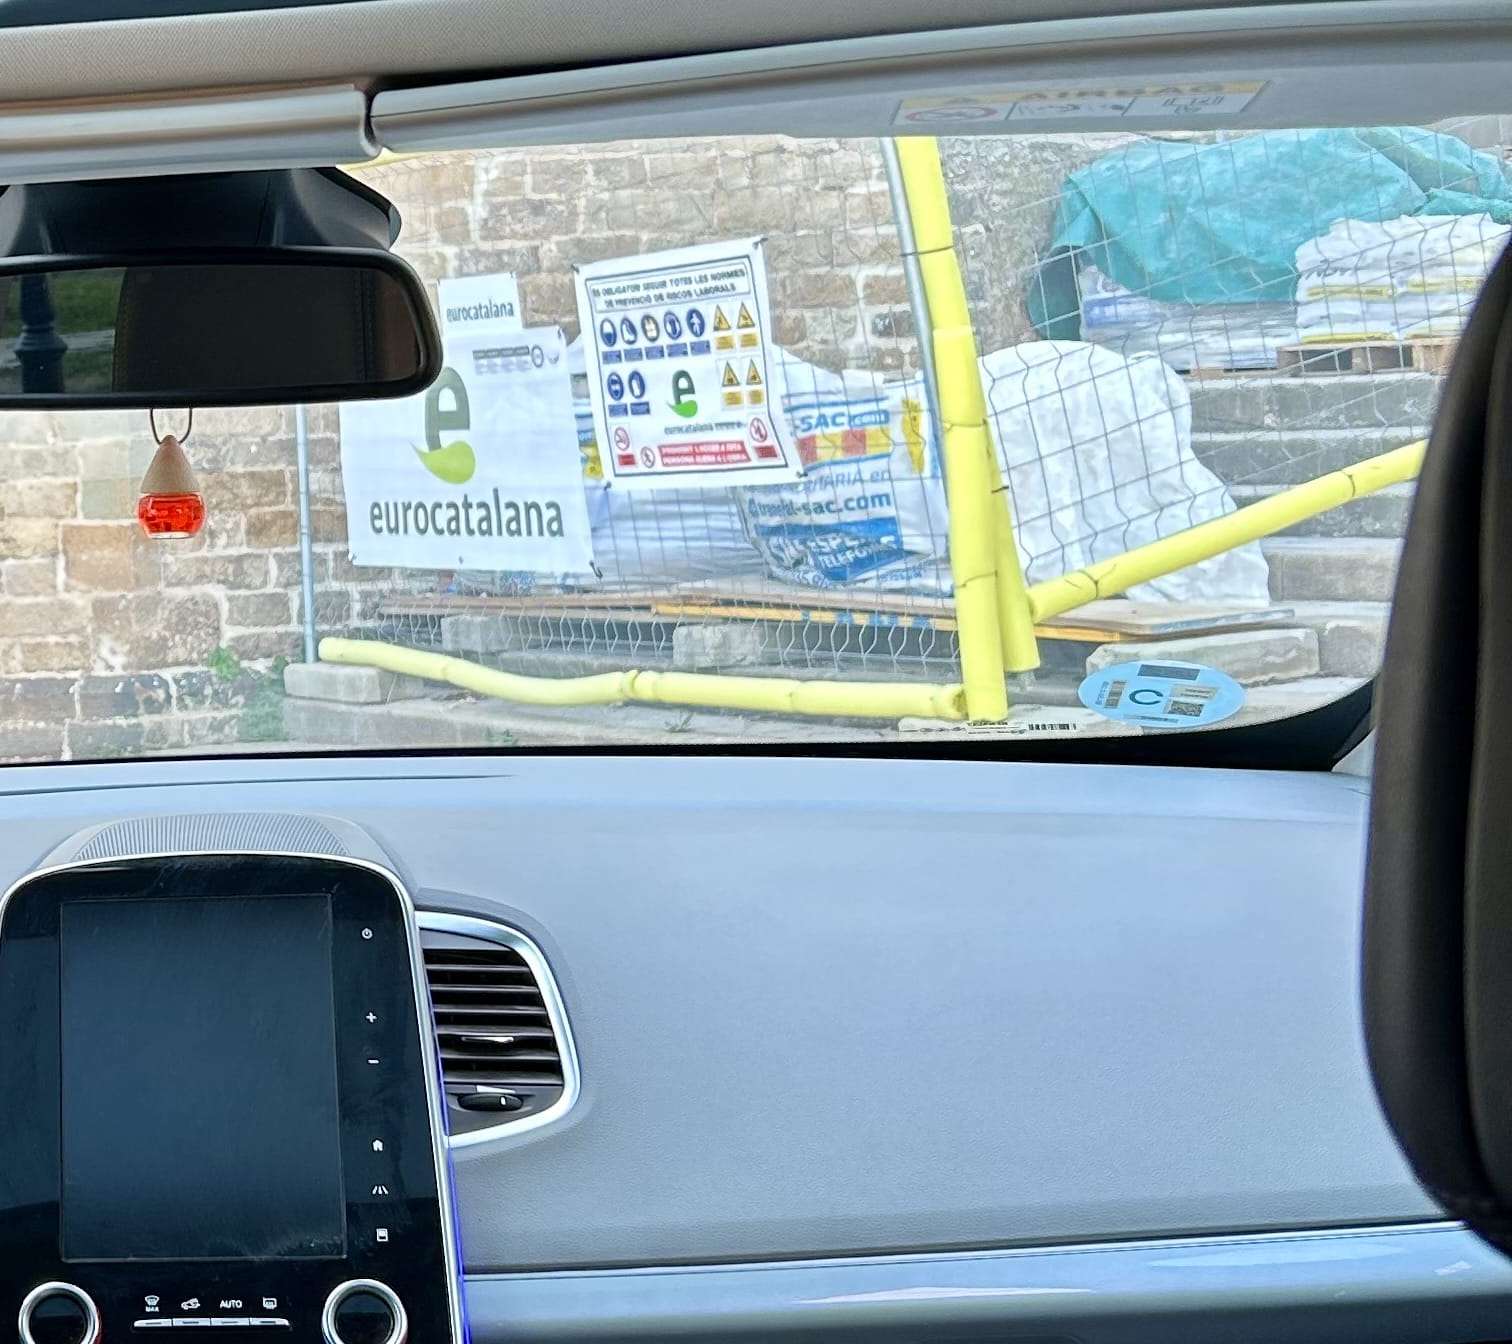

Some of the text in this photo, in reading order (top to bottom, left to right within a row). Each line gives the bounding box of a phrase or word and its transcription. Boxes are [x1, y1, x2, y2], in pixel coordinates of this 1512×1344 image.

[669, 276, 693, 287] TOTES
[694, 273, 708, 284] LES
[710, 268, 746, 281] NORMES
[694, 283, 736, 297] LABORALS
[446, 299, 515, 323] eurocatalana
[369, 487, 564, 538] eurocatalana
[1128, 688, 1164, 706] C
[219, 1299, 243, 1309] AUTO
